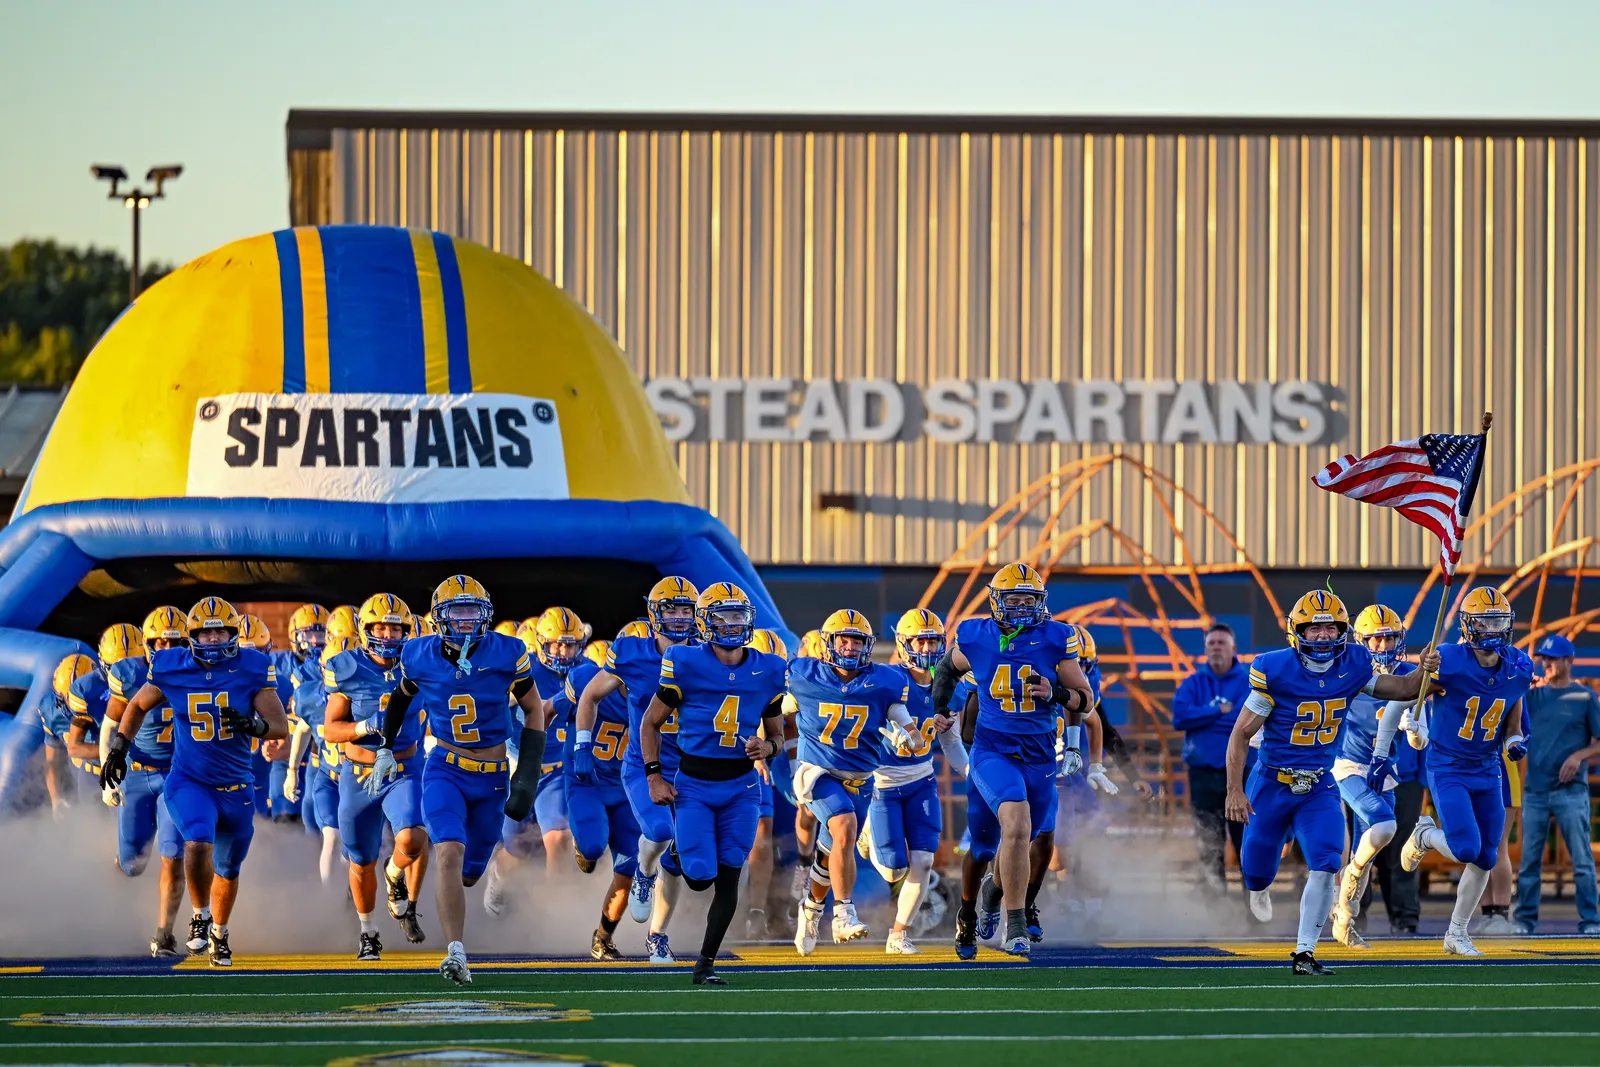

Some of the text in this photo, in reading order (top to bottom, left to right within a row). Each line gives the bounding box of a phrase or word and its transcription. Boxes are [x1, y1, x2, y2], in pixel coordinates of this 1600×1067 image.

[645, 377, 1326, 443] STEAD SPARTANS
[224, 407, 534, 468] SPARTANS
[989, 664, 1036, 712] 41
[187, 692, 234, 742] 51
[449, 694, 480, 743] 2
[714, 695, 740, 748] 4
[818, 703, 869, 749] 77
[1290, 698, 1347, 746] 25
[1457, 695, 1506, 741] 14
